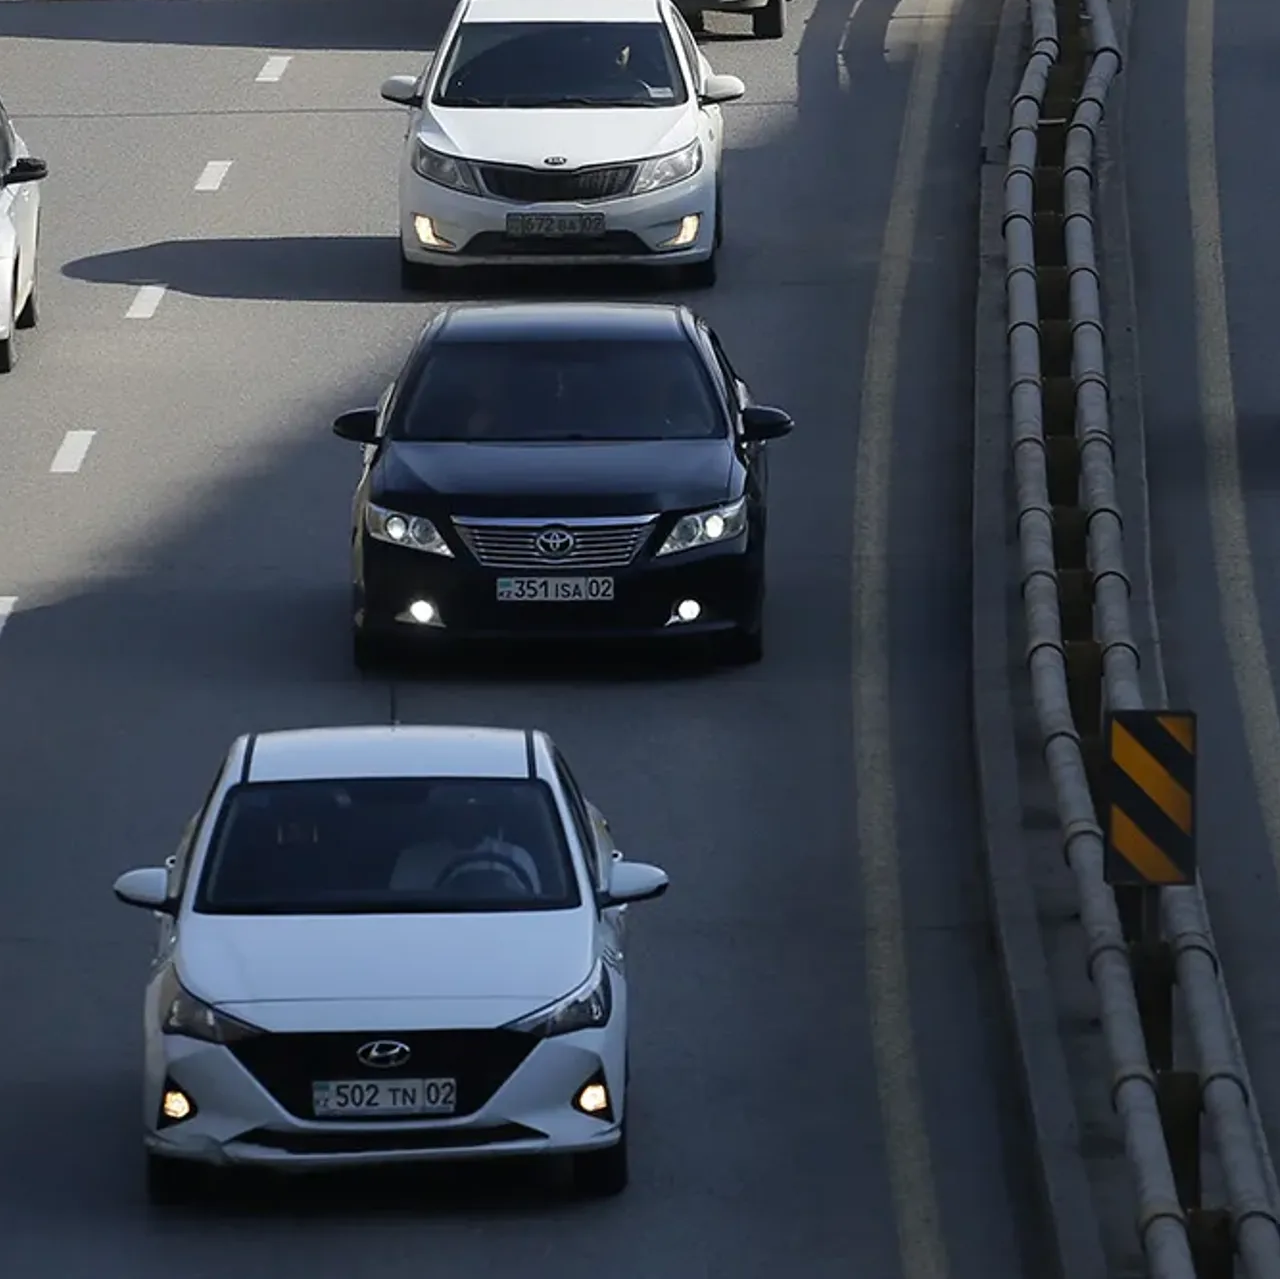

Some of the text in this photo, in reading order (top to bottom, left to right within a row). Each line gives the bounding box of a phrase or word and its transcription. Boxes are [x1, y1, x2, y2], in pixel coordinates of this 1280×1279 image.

[588, 578, 612, 598] 02
[335, 1083, 380, 1108] 502
[387, 1087, 417, 1107] TN
[425, 1081, 455, 1106] 02
